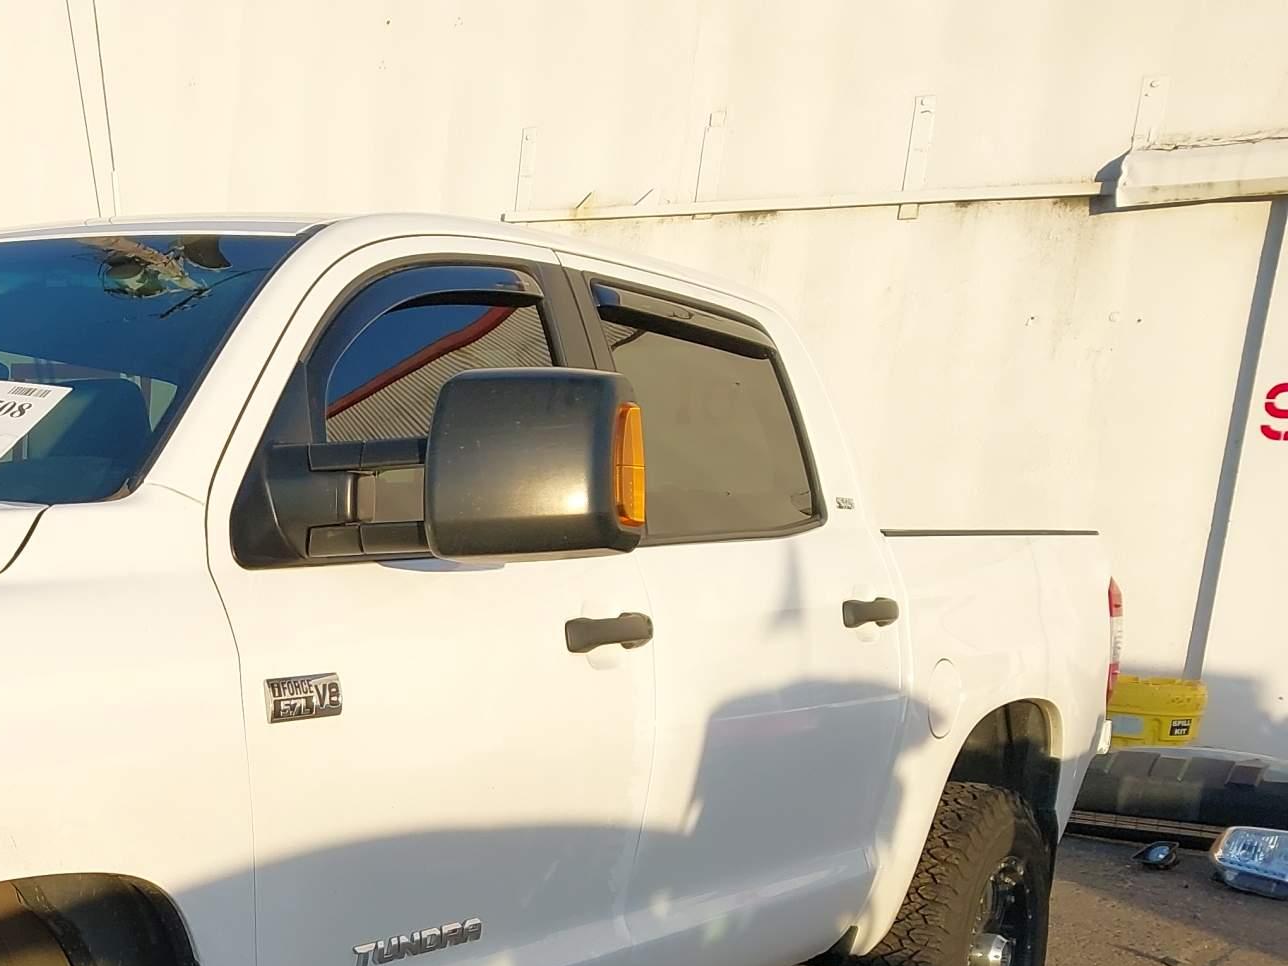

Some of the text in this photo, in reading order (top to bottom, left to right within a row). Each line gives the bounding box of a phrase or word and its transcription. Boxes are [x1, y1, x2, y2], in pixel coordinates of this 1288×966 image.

[314, 682, 341, 710] V8
[1172, 719, 1191, 727] SPILL
[1174, 728, 1188, 736] KIT
